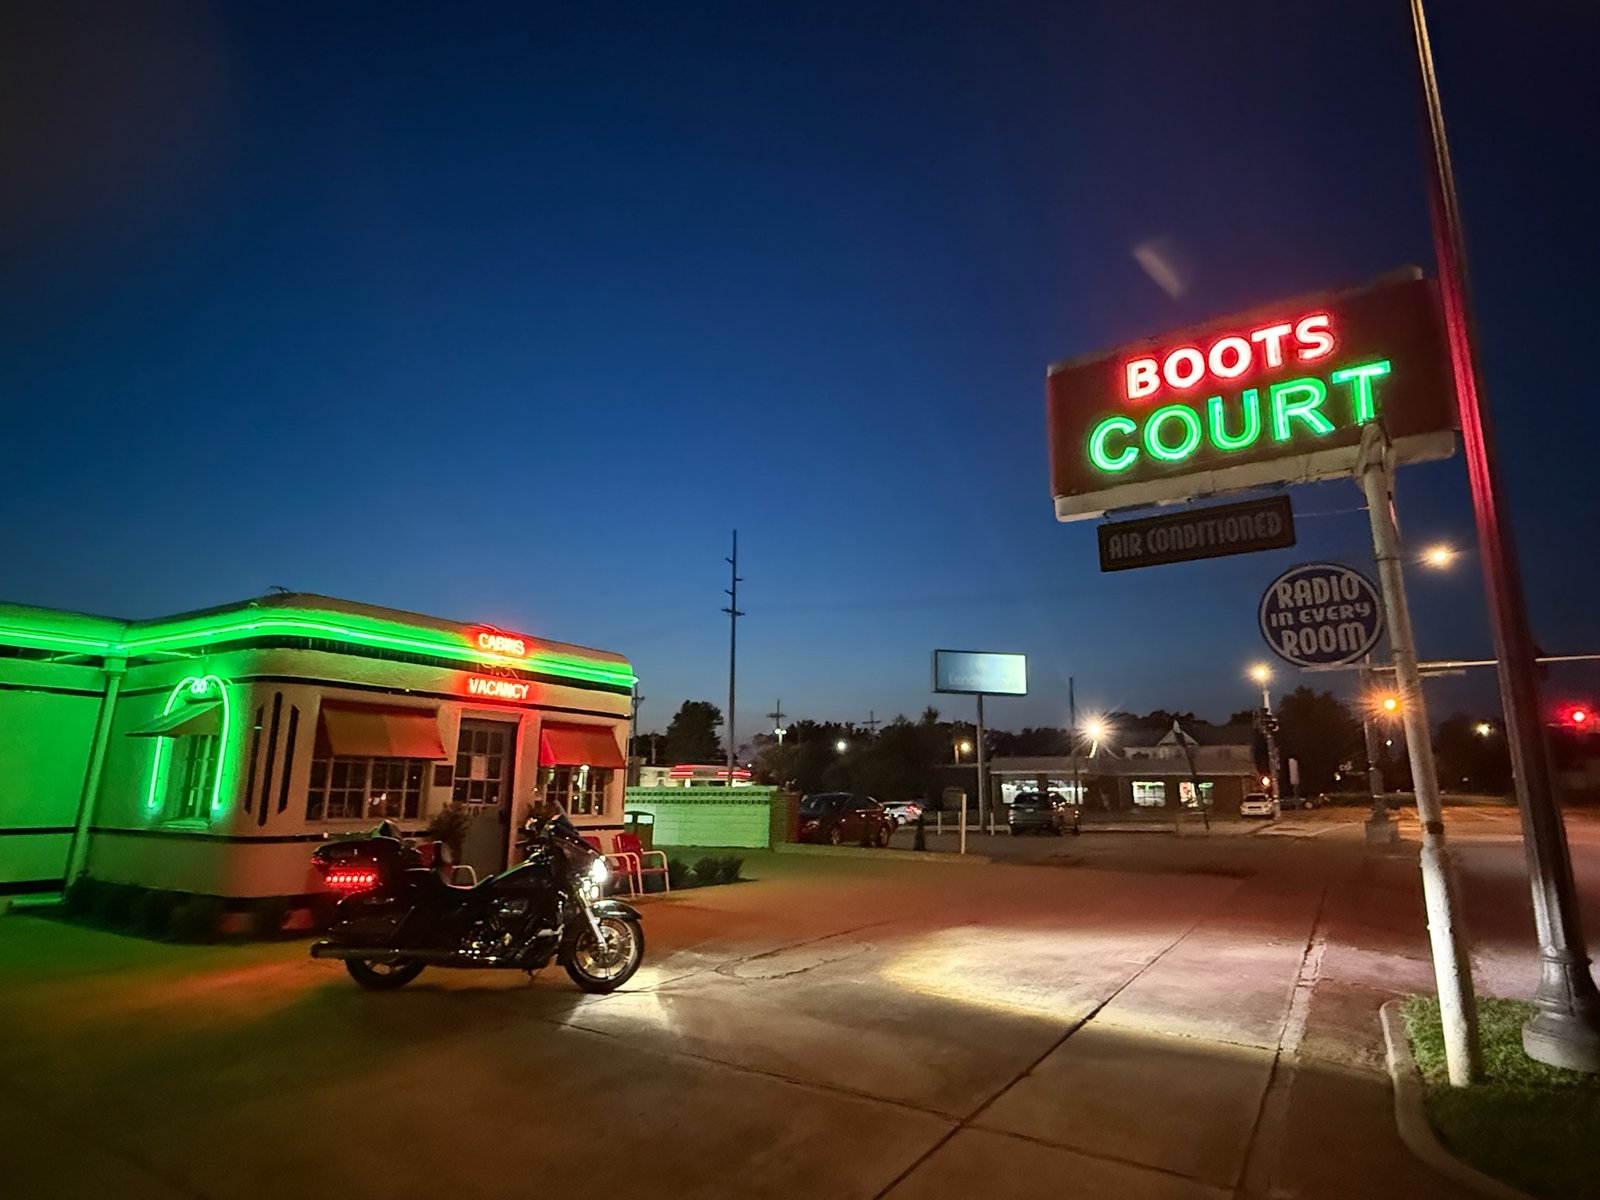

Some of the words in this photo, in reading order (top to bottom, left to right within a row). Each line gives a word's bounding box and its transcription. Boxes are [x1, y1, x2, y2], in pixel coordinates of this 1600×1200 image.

[1126, 314, 1335, 398] BOOTS
[1087, 360, 1391, 473] COURT
[1109, 532, 1143, 559] AIR
[1146, 512, 1282, 554] CONDITIONED
[1276, 570, 1360, 609] RADIO
[1299, 602, 1371, 624] EVERY
[478, 633, 525, 655] CABINS
[1281, 622, 1367, 656] ROOM
[469, 677, 529, 699] VACANCY
